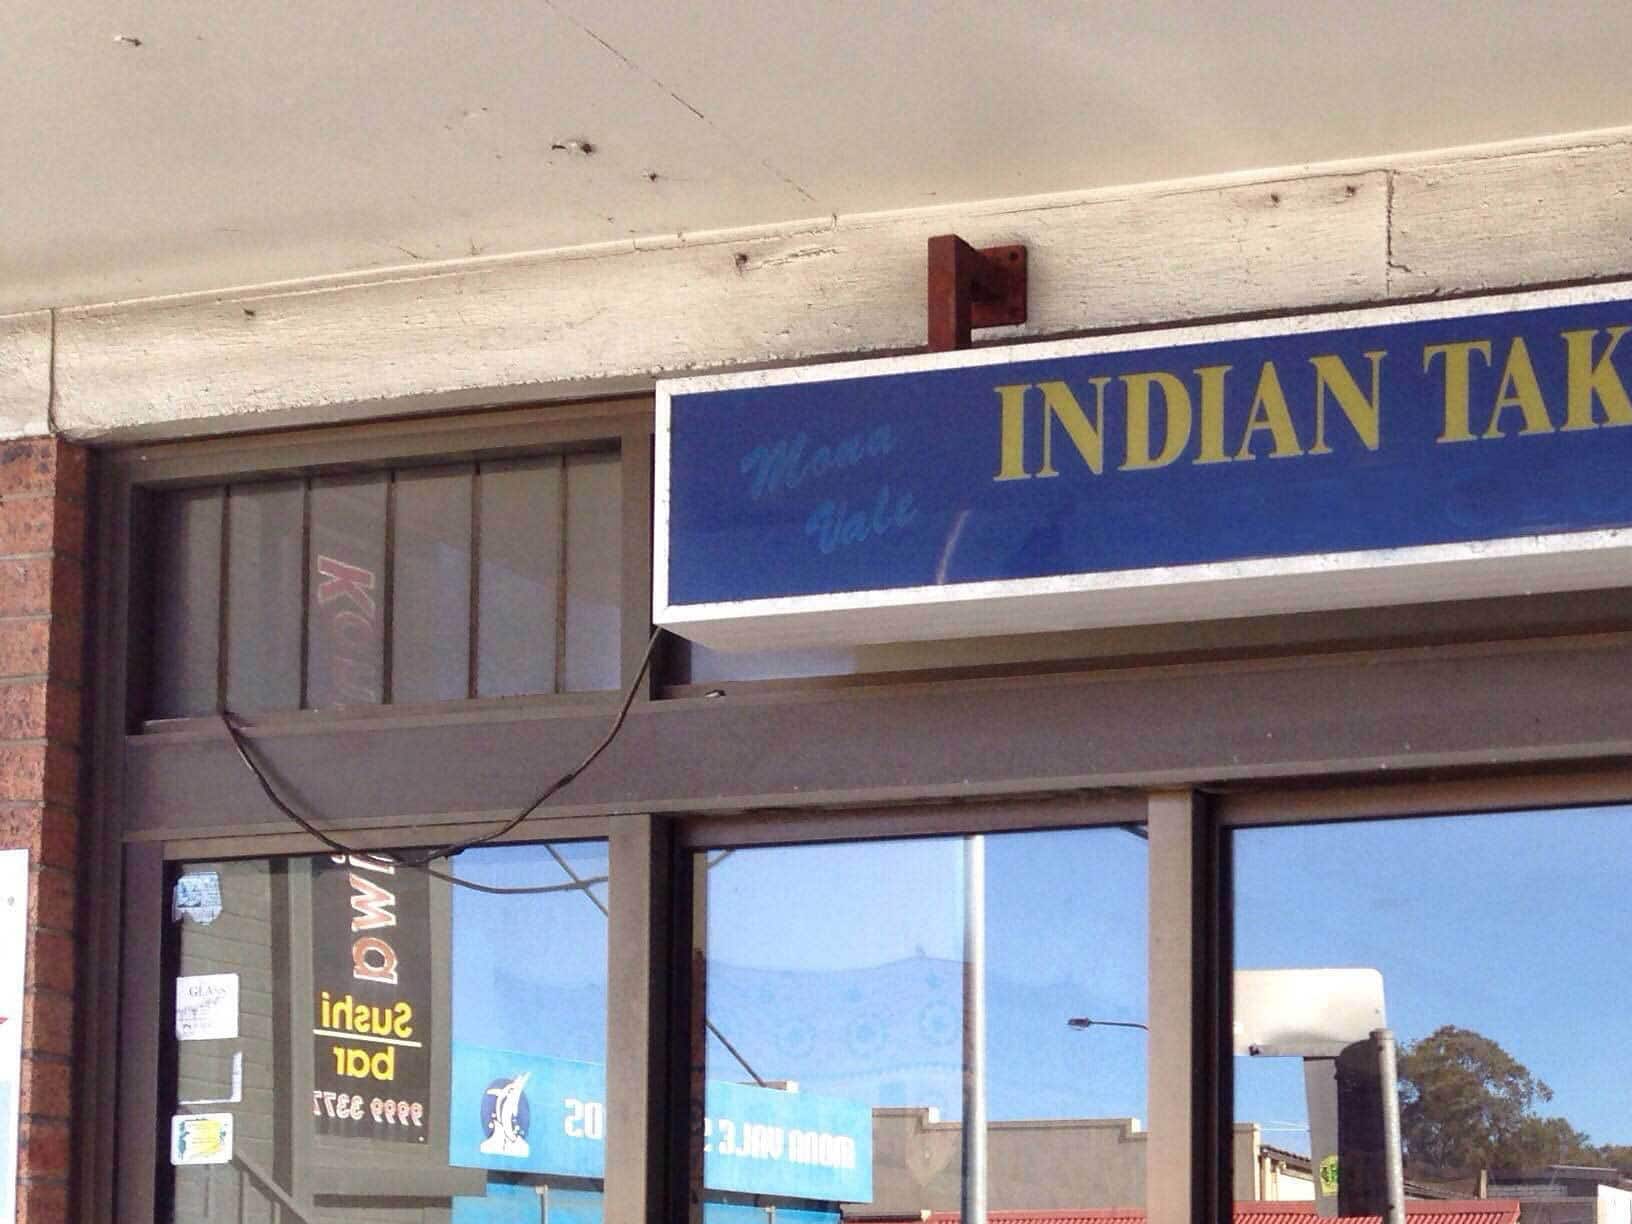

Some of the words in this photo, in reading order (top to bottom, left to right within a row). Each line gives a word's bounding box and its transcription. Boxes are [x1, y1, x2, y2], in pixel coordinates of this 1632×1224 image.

[993, 350, 1388, 481] INDIAN
[741, 426, 894, 499] Mona
[805, 492, 917, 555] Vale
